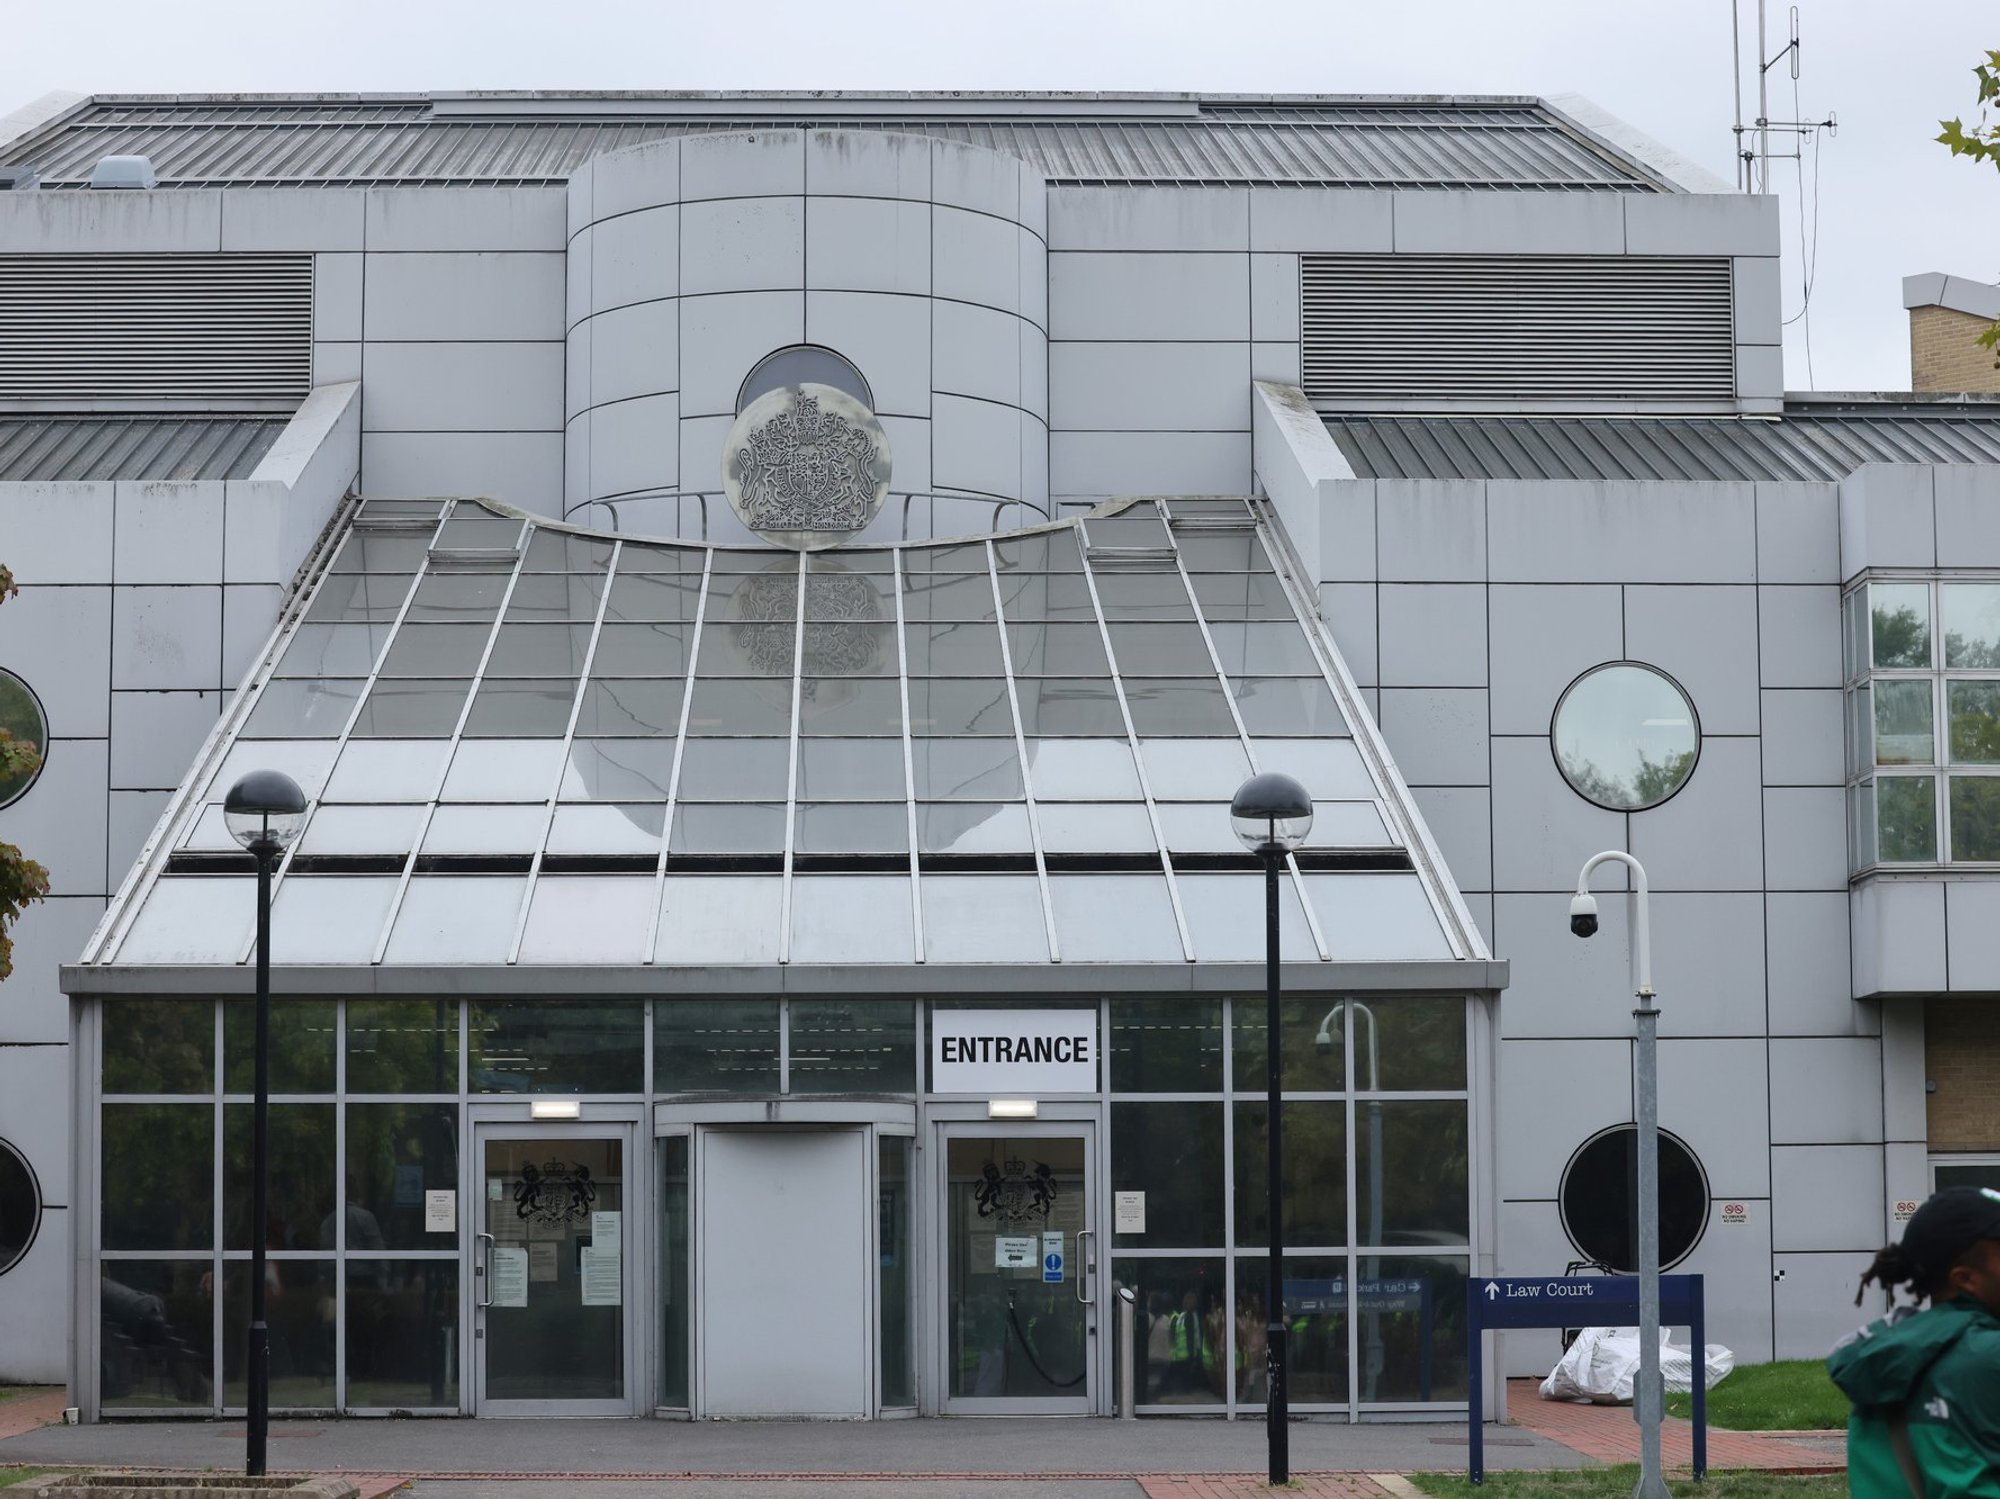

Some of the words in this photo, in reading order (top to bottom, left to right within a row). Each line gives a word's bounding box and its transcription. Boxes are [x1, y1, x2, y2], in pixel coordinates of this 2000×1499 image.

[941, 1036, 1089, 1063] ENTRANCE
[1506, 1283, 1541, 1297] Law
[1547, 1282, 1593, 1297] Court
